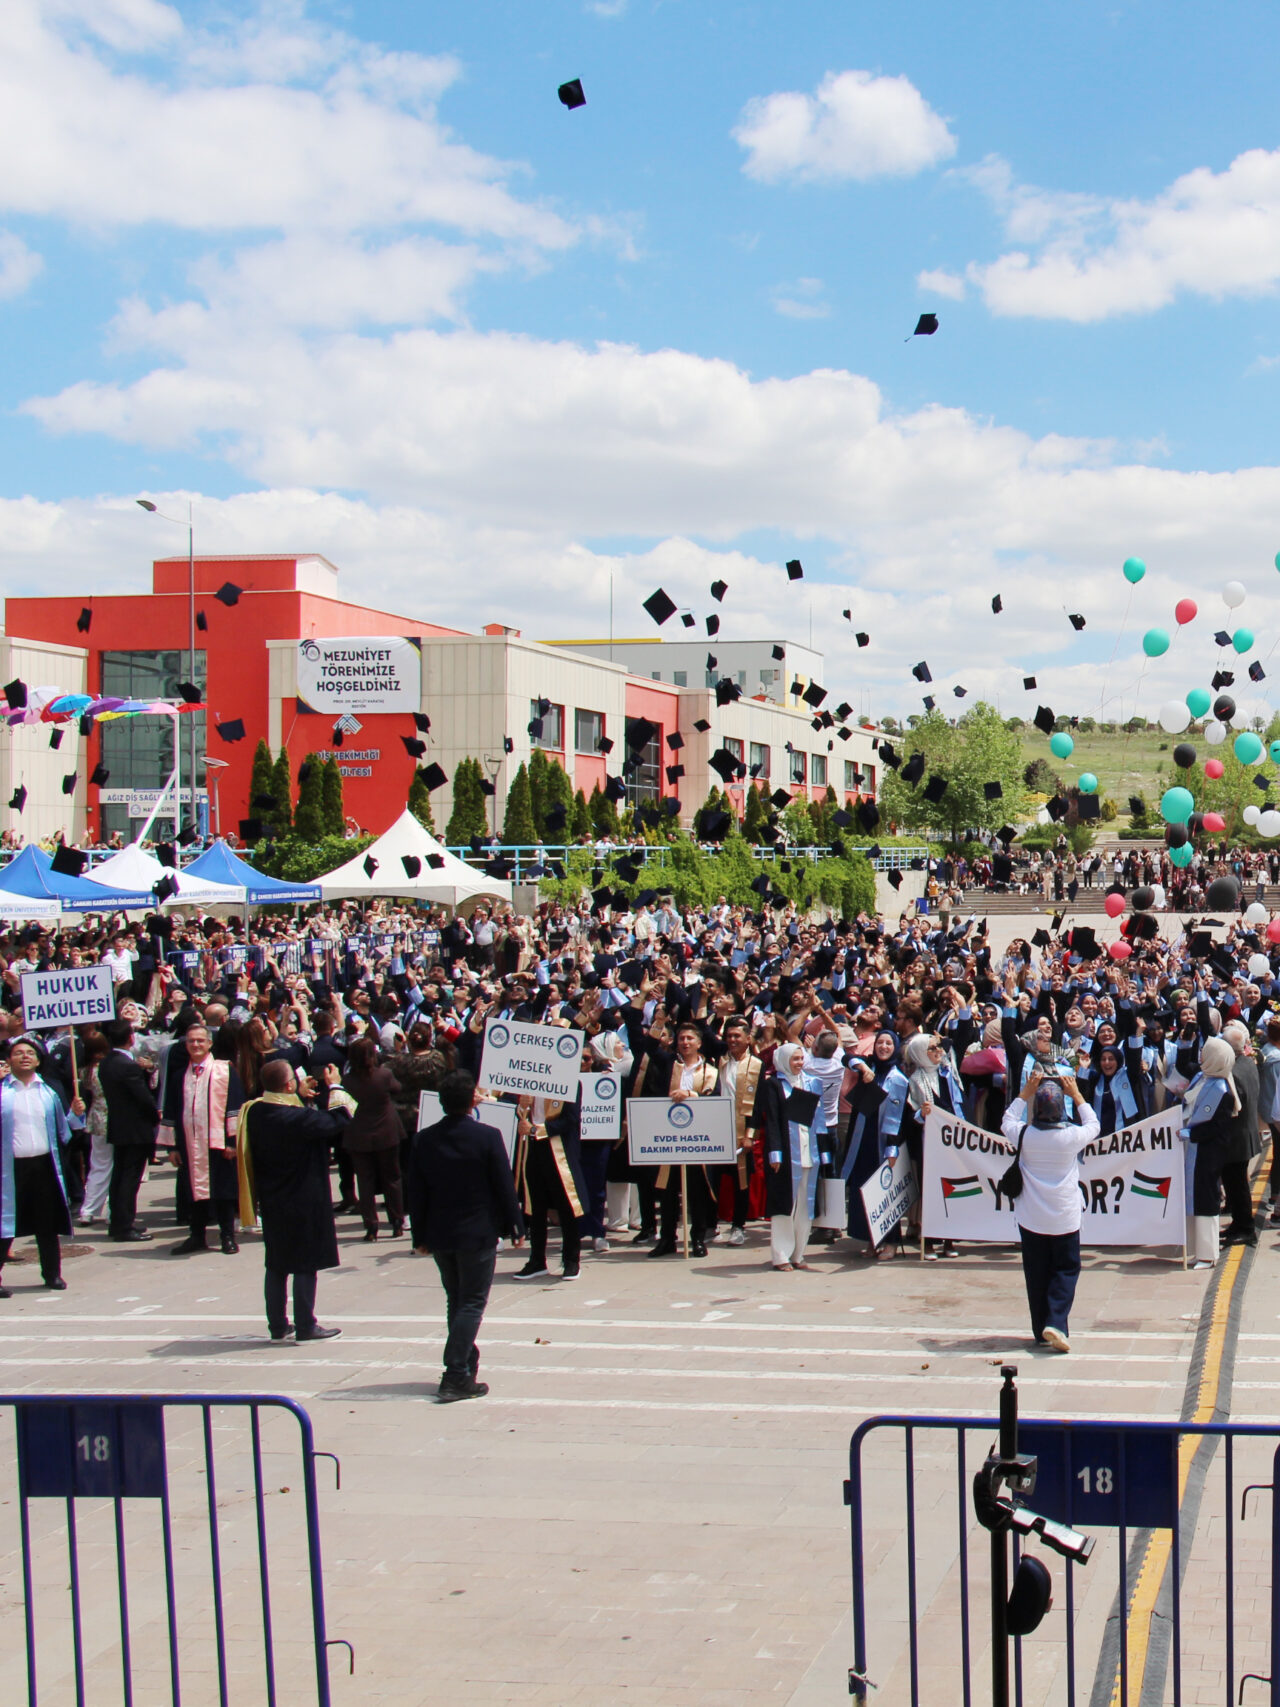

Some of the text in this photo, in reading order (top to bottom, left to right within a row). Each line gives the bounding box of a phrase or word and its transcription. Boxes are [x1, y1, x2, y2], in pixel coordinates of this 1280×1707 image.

[324, 647, 391, 661] MEZUNİYET
[321, 662, 396, 676] TÖRENİMİZE
[317, 678, 401, 694] HOŞGELDİNİZ
[340, 766, 372, 776] ÜLTESİ
[37, 975, 98, 995] HUKUK
[28, 994, 111, 1021] FAKÜLTESİ
[514, 1032, 554, 1050] ÇERKEŞ
[509, 1058, 552, 1074] MESLEK
[489, 1072, 568, 1095] YÜKSEKOKULU
[581, 1115, 614, 1124] LOJİLERİ
[1151, 1126, 1172, 1150] MI
[675, 1145, 725, 1153] PROGRAMI
[77, 1436, 110, 1462] 18
[1077, 1466, 1113, 1494] 18
